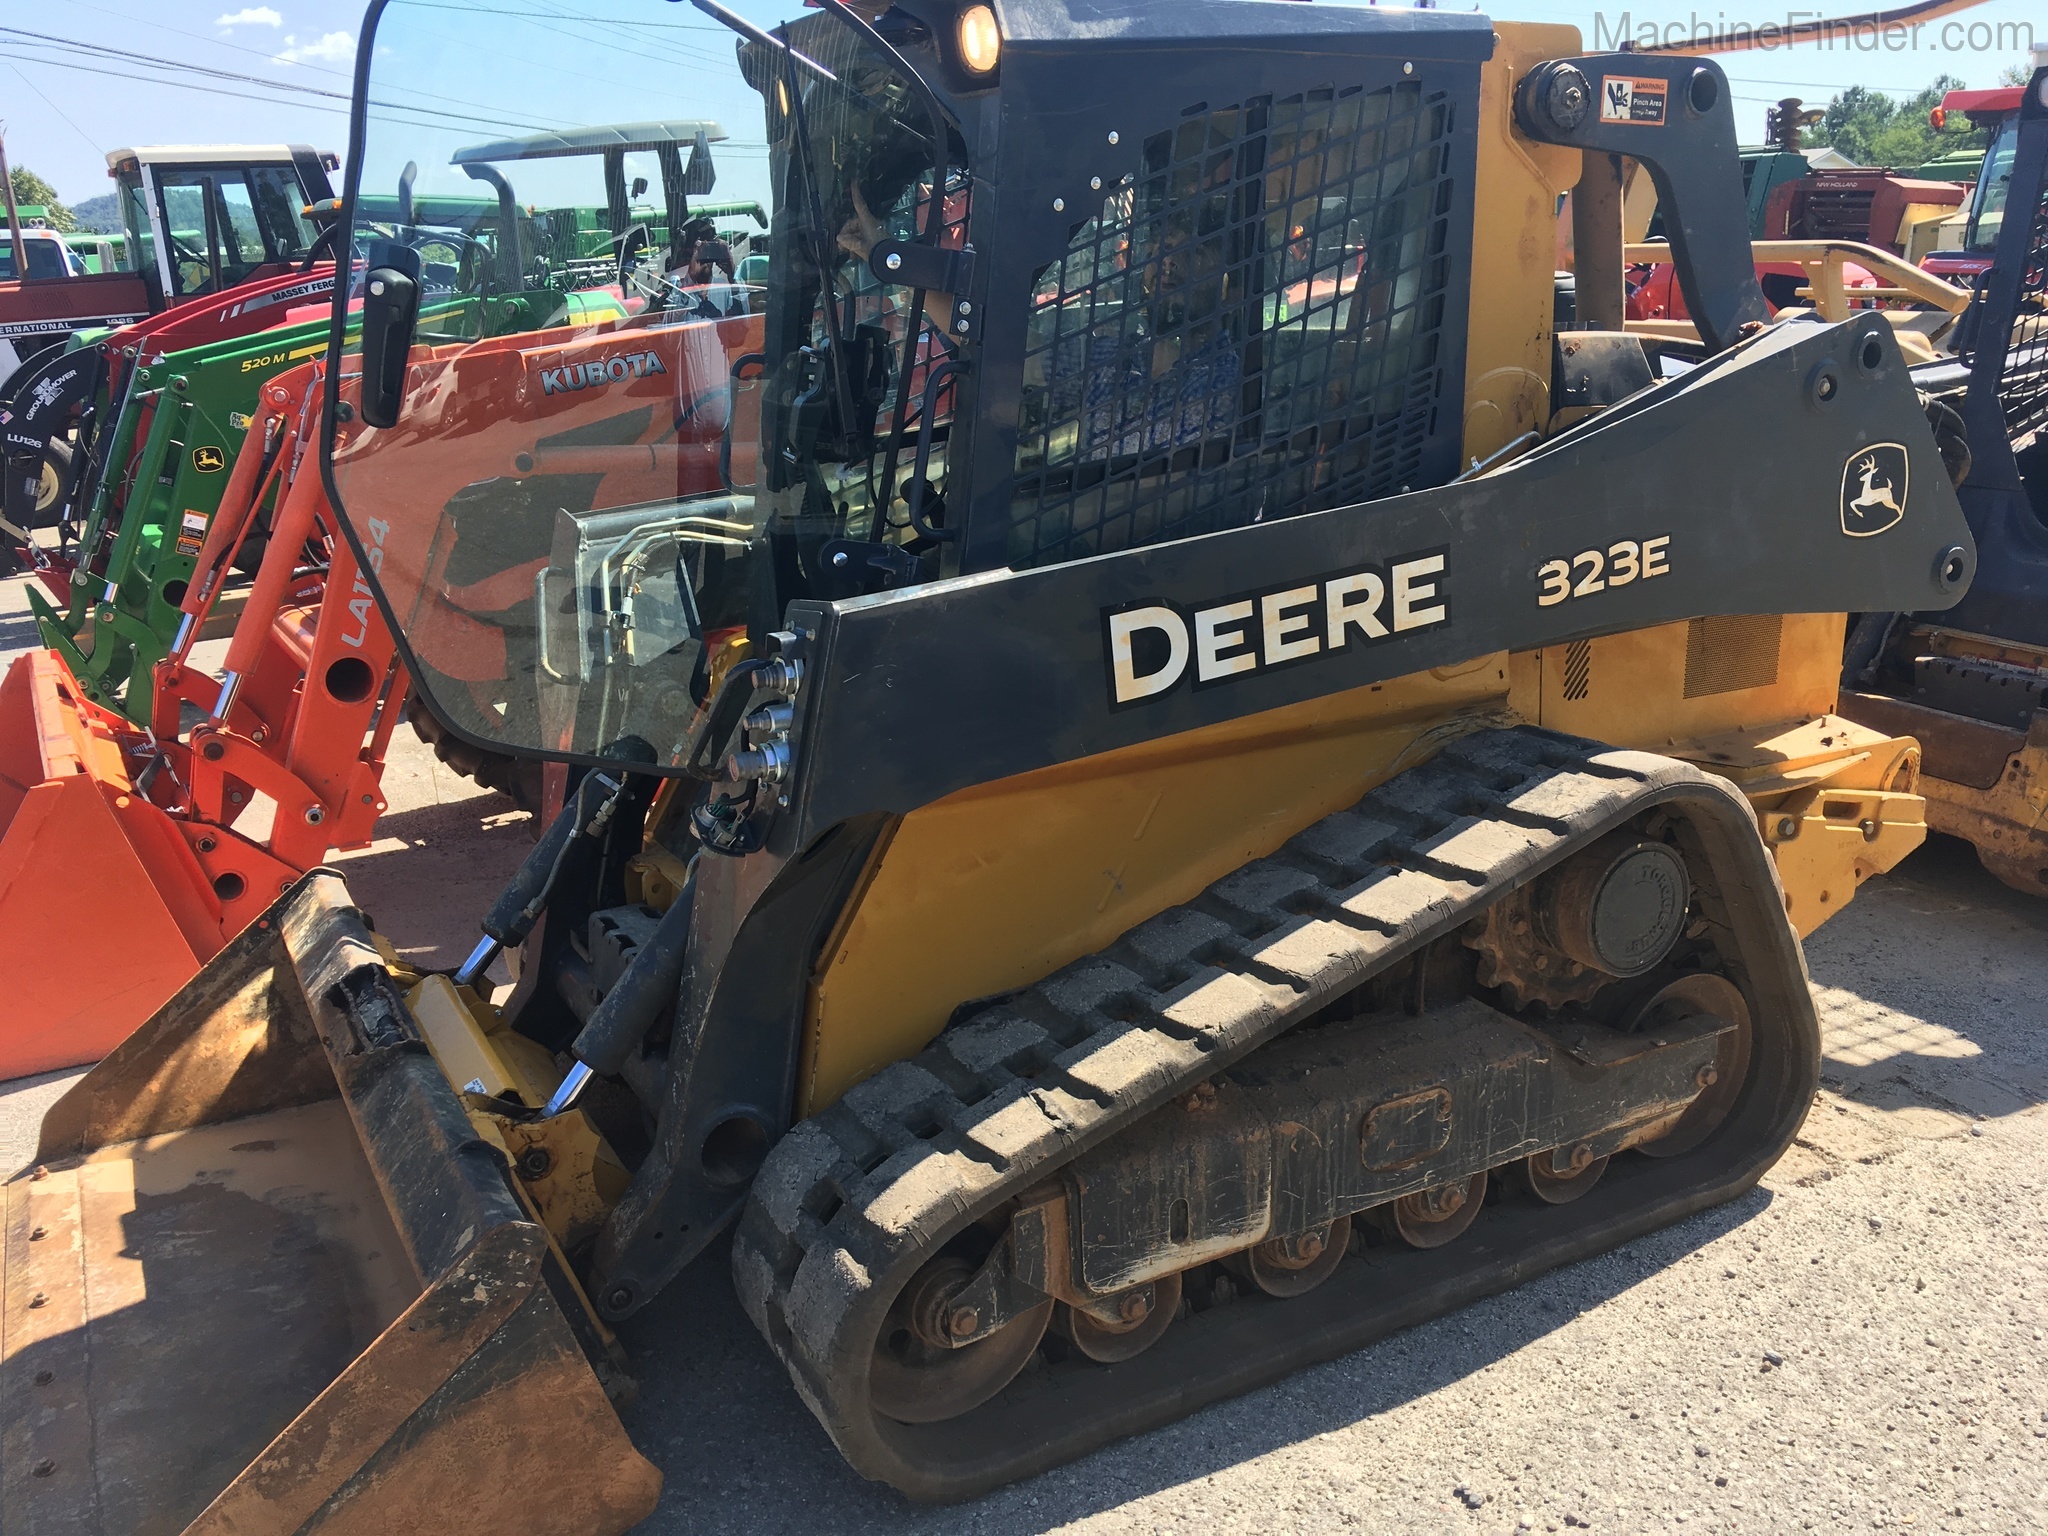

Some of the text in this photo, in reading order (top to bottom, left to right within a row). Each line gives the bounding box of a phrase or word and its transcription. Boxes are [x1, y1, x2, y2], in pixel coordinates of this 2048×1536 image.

[1633, 98, 1662, 107] Pinch Area
[271, 285, 311, 302] MASSEY
[240, 353, 286, 373] 520 M
[540, 351, 668, 396] KUBOTA
[26, 369, 78, 421] GROUNDMOVER
[7, 433, 43, 448] LU126
[1537, 535, 1671, 607] 323E
[1109, 554, 1446, 703] DEERE
